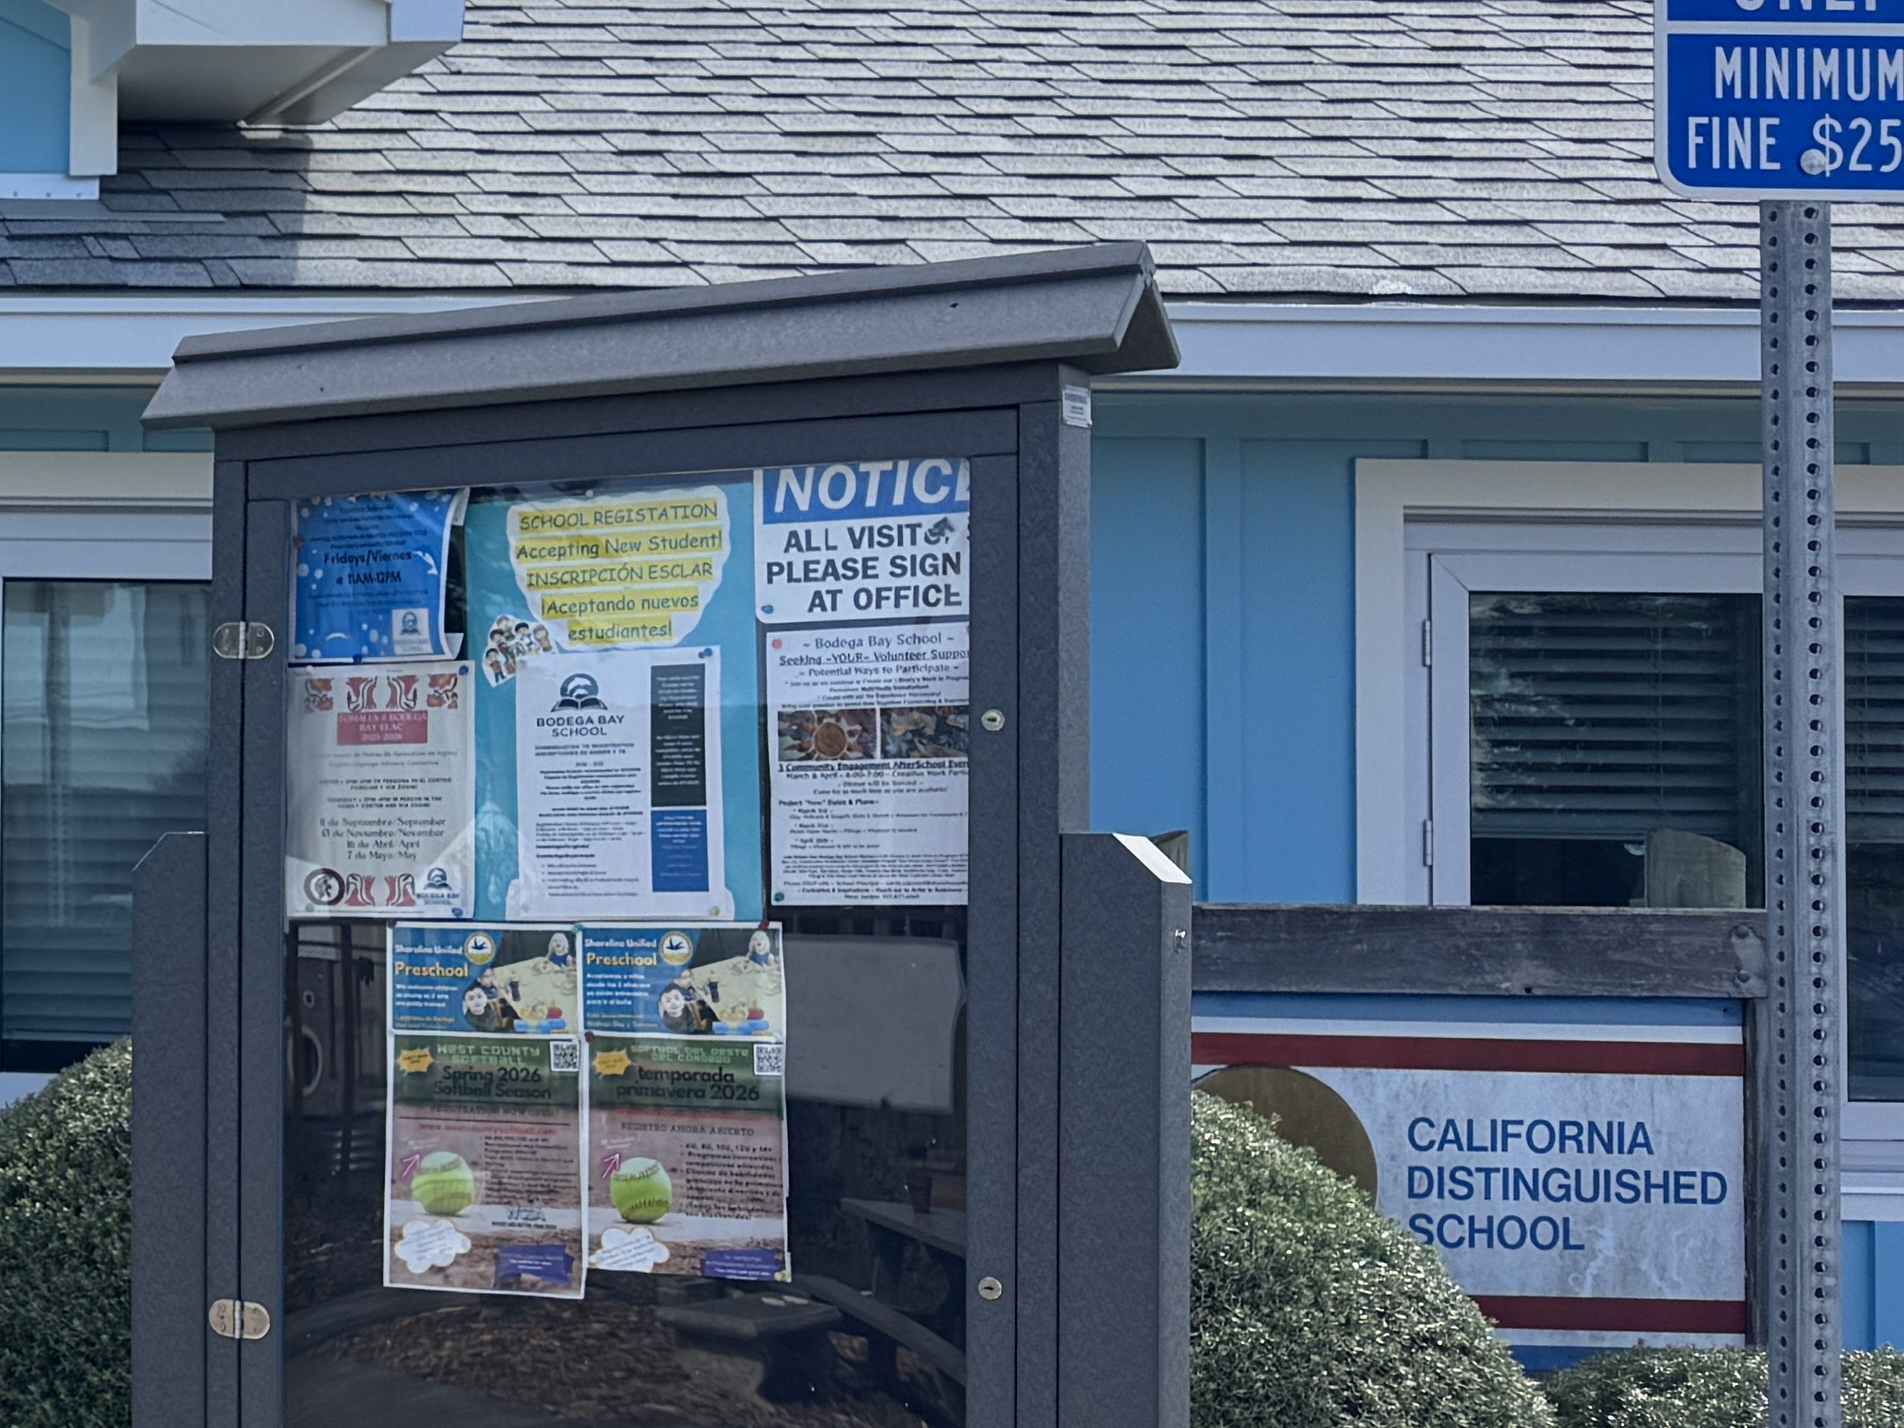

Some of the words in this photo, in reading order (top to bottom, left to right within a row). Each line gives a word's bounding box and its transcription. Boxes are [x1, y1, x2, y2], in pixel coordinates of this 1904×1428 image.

[1714, 46, 1904, 101] MINIMUM
[1687, 117, 1782, 170] FINE
[1811, 112, 1904, 178] $25
[519, 513, 589, 531] SCHOOL
[593, 501, 718, 526] REGISTATION
[516, 542, 599, 561] Accepting
[605, 538, 642, 555] New
[783, 528, 838, 554] ALL
[526, 562, 643, 588] INSCRIPCIÓN
[648, 561, 713, 580] ESCLAR
[766, 556, 880, 585] PLEASE
[888, 551, 961, 578] SIGN
[642, 593, 699, 610] nuevos
[807, 589, 843, 613] AT
[852, 583, 963, 611] OFFICE
[814, 638, 863, 650] Bodega
[868, 636, 892, 649] Bay
[896, 632, 942, 646] School
[779, 655, 822, 667] Seeking
[874, 650, 926, 662] Volunteer
[808, 666, 852, 678] Potential
[536, 715, 594, 728] BODEGA
[598, 715, 625, 726] BAY
[551, 726, 608, 738] SCHOOL
[395, 961, 469, 977] Preschool
[586, 952, 658, 966] Preschool
[481, 1045, 541, 1057] COUNTY
[442, 1065, 492, 1085] Spring
[497, 1067, 542, 1084] 2026
[638, 1066, 735, 1085] temporada
[433, 1080, 492, 1097] Softball
[495, 1083, 552, 1100] Season
[615, 1081, 706, 1101] primavera
[710, 1084, 760, 1102] 2026
[1406, 1116, 1655, 1156] CALIFORNIA
[1406, 1165, 1729, 1205] DISTINGUISHED
[1407, 1212, 1586, 1251] SCHOOL
